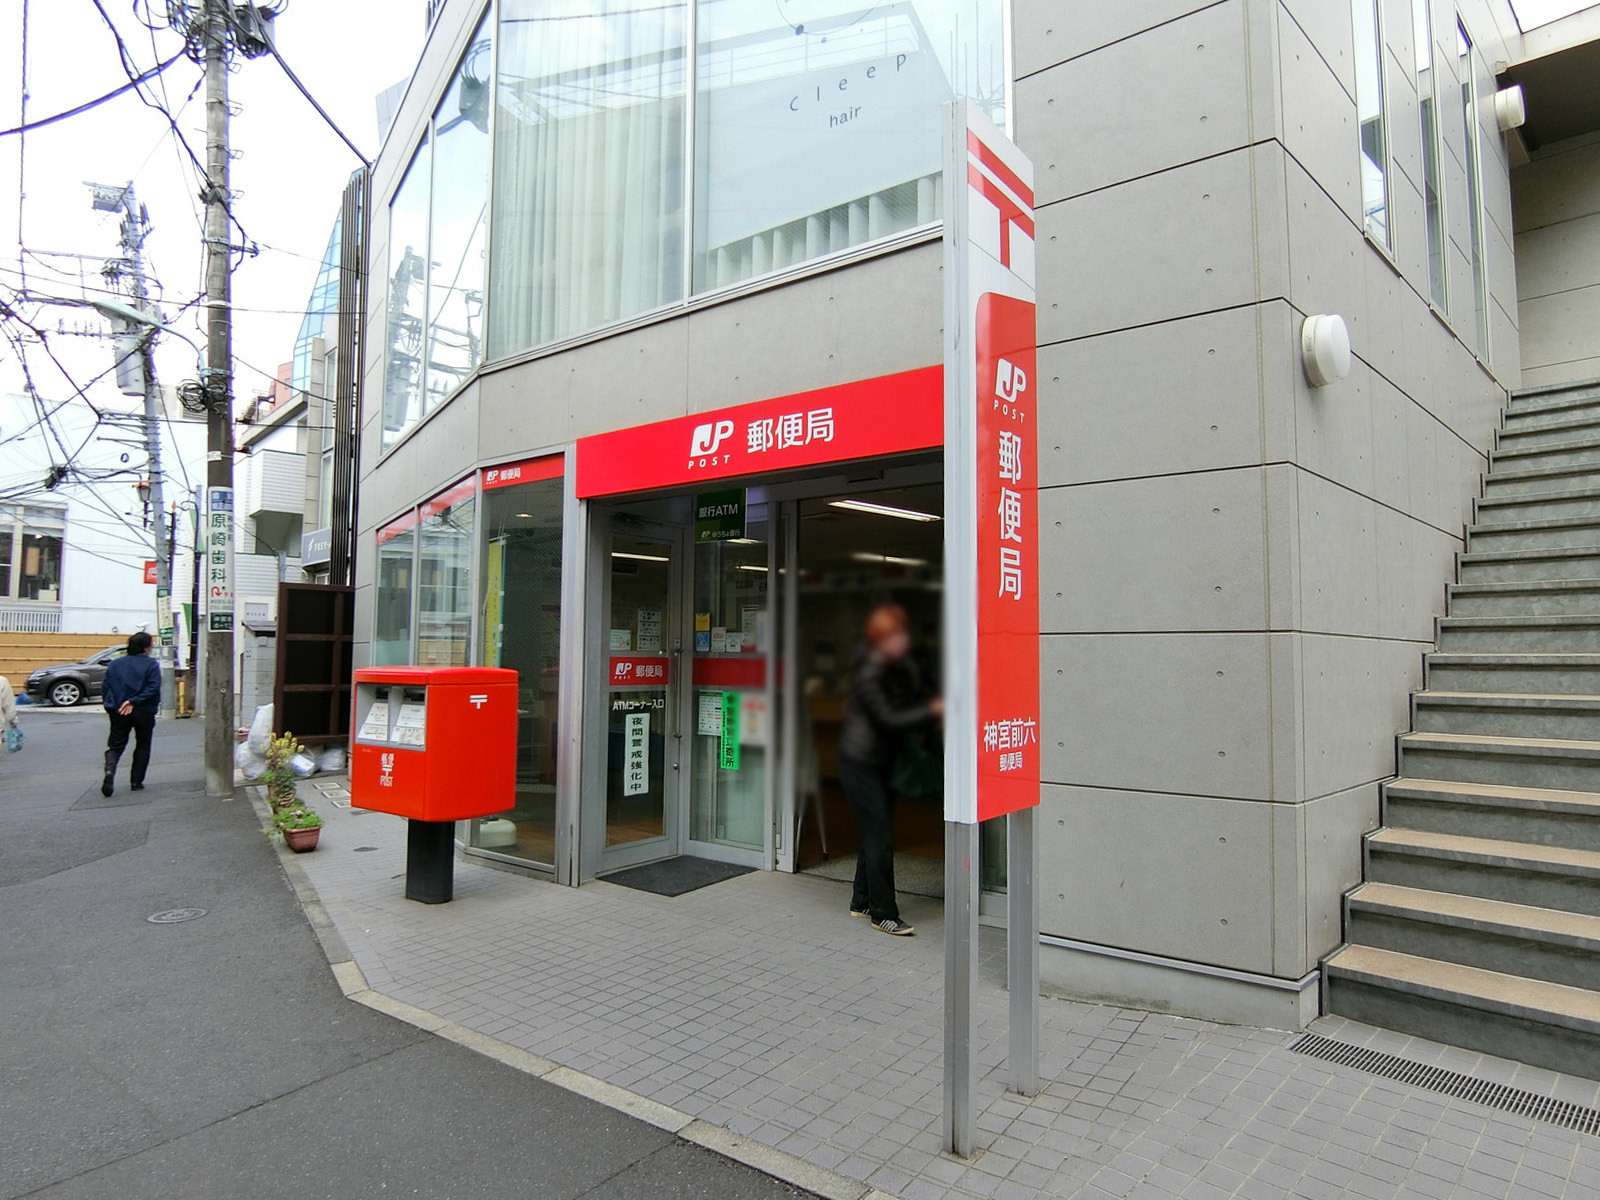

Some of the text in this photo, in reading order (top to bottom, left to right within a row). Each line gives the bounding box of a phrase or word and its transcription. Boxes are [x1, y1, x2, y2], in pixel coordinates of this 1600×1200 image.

[829, 105, 862, 128] hair
[993, 399, 1026, 423] POST
[747, 407, 835, 454] 郵便局
[687, 454, 731, 470] POST
[500, 467, 521, 481] 郵便局
[698, 503, 738, 519] 銀行ATM
[997, 429, 1022, 601] 郵便局
[635, 664, 664, 678] 郵便局
[612, 698, 665, 712] ATMコーナー入口
[983, 716, 1037, 752] 神宮前六
[629, 716, 644, 792] 夜間警戒強化中
[998, 751, 1024, 772] 郵便局
[380, 775, 394, 788] POST
